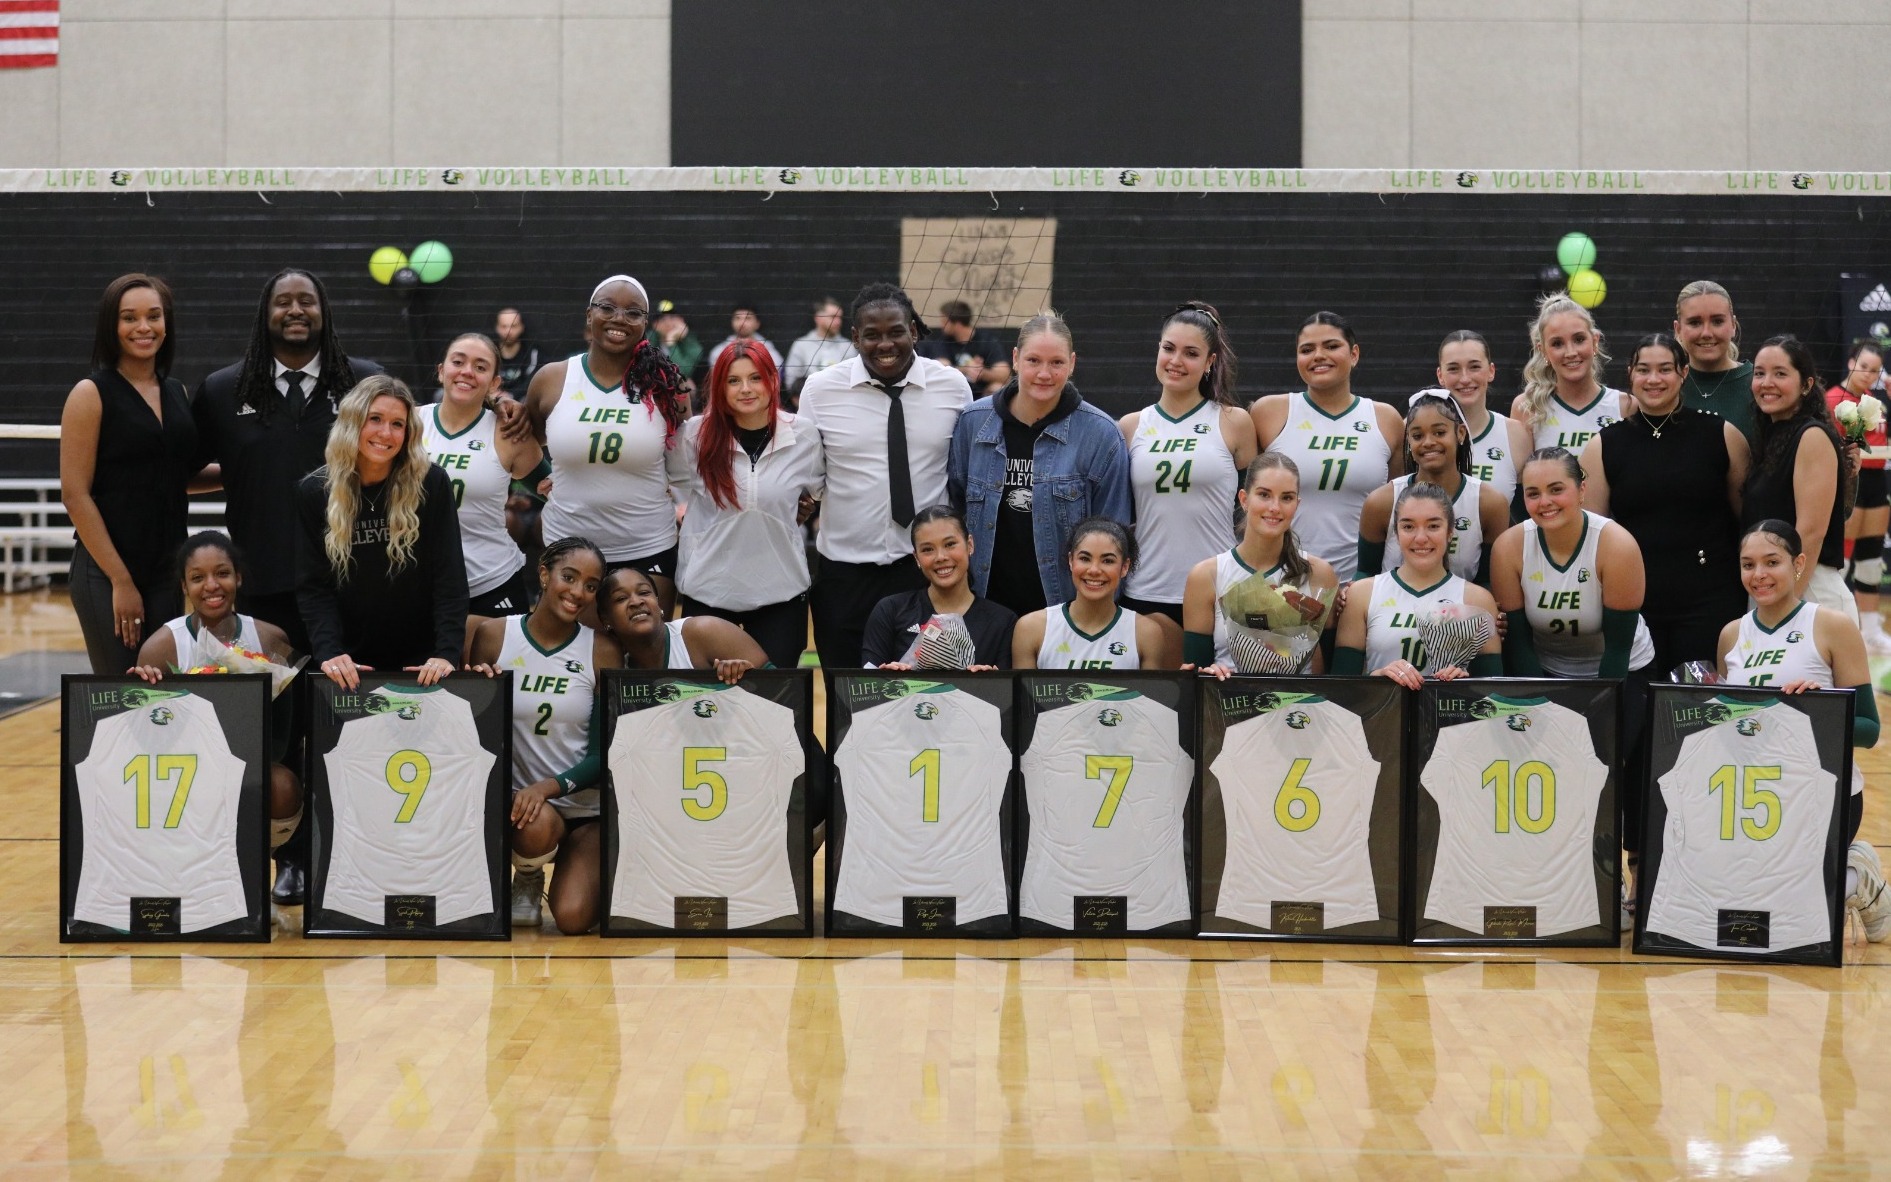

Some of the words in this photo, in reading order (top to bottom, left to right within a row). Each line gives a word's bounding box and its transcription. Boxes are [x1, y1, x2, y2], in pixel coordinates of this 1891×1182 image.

[46, 169, 97, 187] LIFE
[145, 169, 296, 186] VOLLEYBALL
[377, 169, 429, 186] LIFE
[477, 169, 631, 186] VOLLEYBALL
[713, 168, 766, 185] LIFE
[814, 168, 968, 186] VOLLEYBALL
[1053, 169, 1105, 186] LIFE
[1156, 168, 1307, 187] VOLLEYBALL
[1390, 171, 1443, 188] LIFE
[1492, 171, 1645, 189] VOLLEYBALL
[1727, 173, 1778, 189] LIFE
[1828, 173, 1891, 190] VOLL
[579, 407, 630, 424] LIFE
[588, 431, 623, 464] 18
[1149, 438, 1197, 452] LIFE
[1308, 435, 1358, 450] LIFE
[1558, 432, 1596, 447] LIF
[428, 453, 471, 469] IFE
[1155, 459, 1192, 493] 24
[1319, 458, 1349, 491] 11
[1537, 590, 1579, 610] LIFE
[1401, 637, 1428, 671] 10
[1744, 649, 1786, 669] LIFE
[520, 674, 569, 694] LIFE
[623, 685, 650, 697] LIFE
[851, 682, 878, 696] LIFE
[1035, 684, 1062, 697] LIFE
[92, 691, 118, 705] LIFE
[335, 695, 360, 708] LIFE
[1223, 695, 1250, 710] LIFE
[1439, 699, 1466, 711] LIFE
[534, 702, 552, 735] 2
[1675, 707, 1702, 722] LIFE
[124, 755, 197, 829] 17
[385, 749, 431, 823] 9
[681, 747, 728, 820] 5
[909, 749, 940, 822] 1
[1085, 755, 1133, 827] 7
[1275, 759, 1321, 832] 6
[1482, 760, 1557, 834] 10
[1709, 765, 1781, 841] 15
